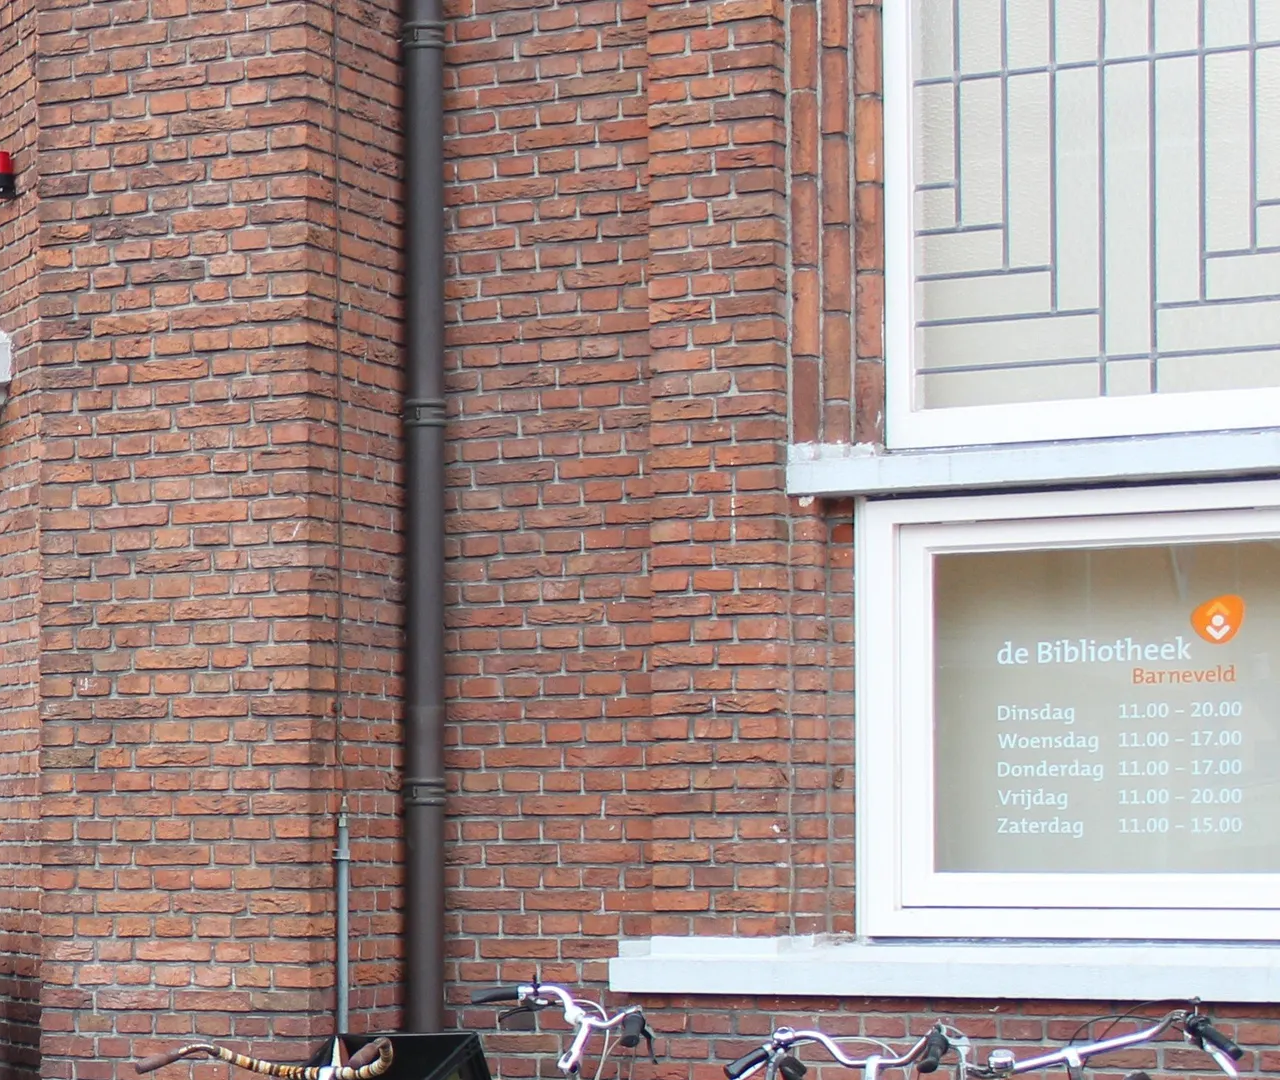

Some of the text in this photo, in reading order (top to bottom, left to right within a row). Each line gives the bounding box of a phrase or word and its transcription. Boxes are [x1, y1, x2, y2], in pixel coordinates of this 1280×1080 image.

[996, 637, 1192, 665] de Bibliotheek
[1132, 665, 1237, 685] Barneveld
[997, 704, 1075, 724] Dinsdag
[1118, 703, 1169, 718] 11.00
[1190, 701, 1242, 718] 20.00
[997, 733, 1099, 752] Woensdag
[1118, 732, 1169, 747] 11.00
[1190, 730, 1242, 747] 17.00
[997, 761, 1104, 781] Donderdag
[1118, 761, 1169, 776] 11.00
[1190, 759, 1242, 775] 17.00
[997, 789, 1068, 810] Vrijdag
[1118, 789, 1169, 805] 11.00
[1190, 788, 1242, 804] 20.00
[997, 817, 1084, 838] Zaterdag
[1118, 817, 1169, 833] 11.00
[1190, 816, 1242, 832] 15.00
